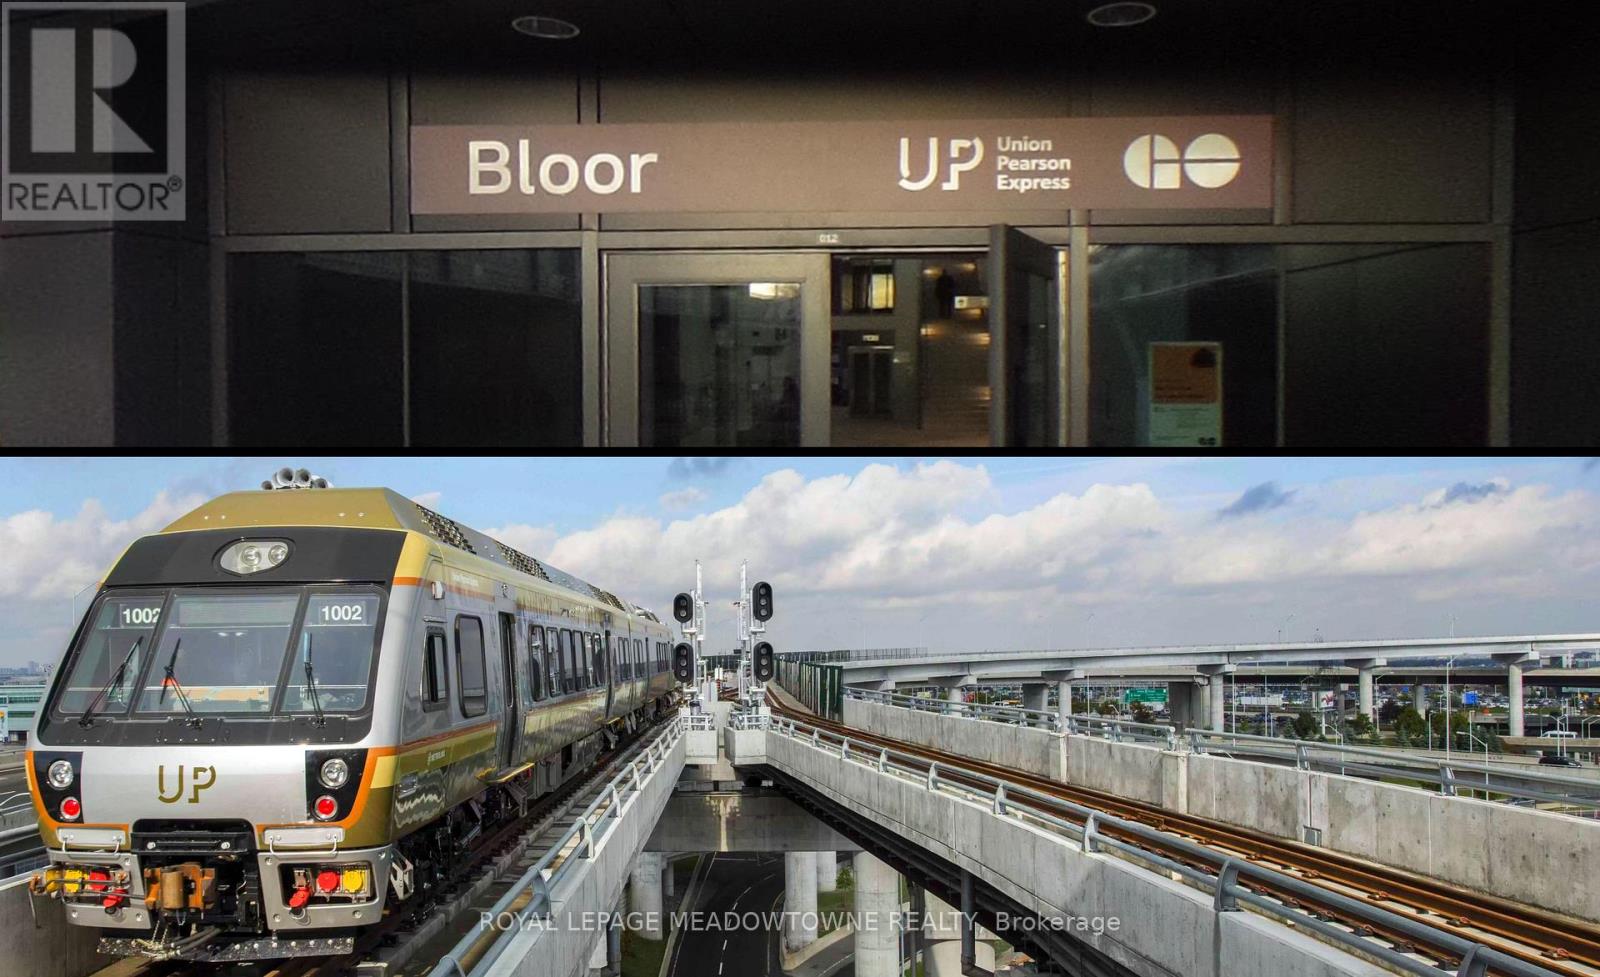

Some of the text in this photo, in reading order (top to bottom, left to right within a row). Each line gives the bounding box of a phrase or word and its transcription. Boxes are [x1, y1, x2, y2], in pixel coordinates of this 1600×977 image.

[997, 136, 1053, 152] Union
[469, 139, 658, 194] Bloor
[899, 137, 984, 191] UP
[997, 155, 1072, 172] Pearson
[997, 174, 1071, 193] Express
[122, 608, 161, 624] 1002
[321, 605, 362, 621] 1002
[158, 765, 217, 804] UP
